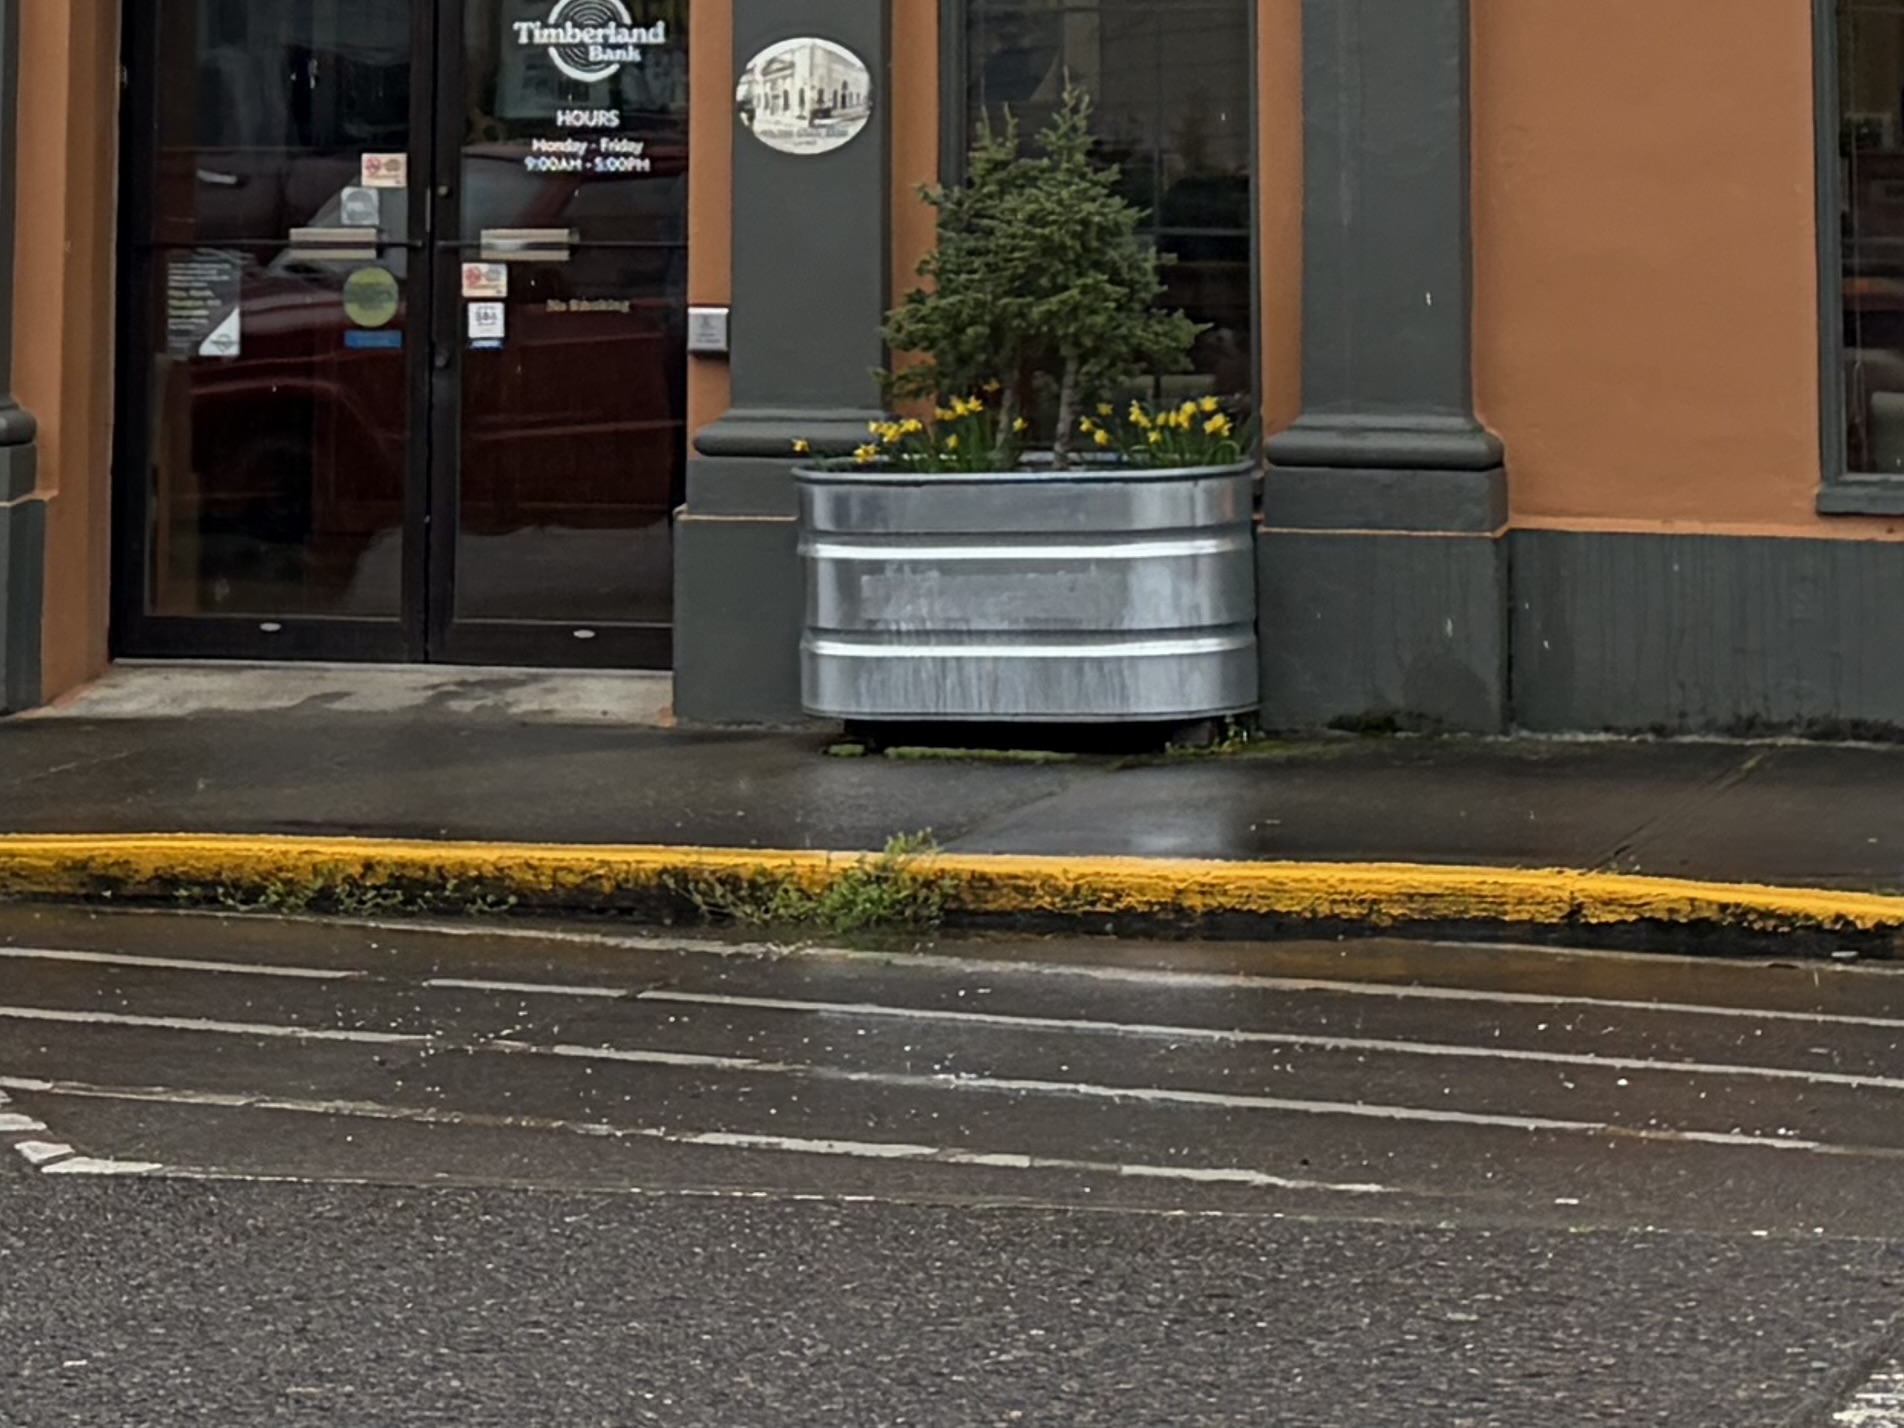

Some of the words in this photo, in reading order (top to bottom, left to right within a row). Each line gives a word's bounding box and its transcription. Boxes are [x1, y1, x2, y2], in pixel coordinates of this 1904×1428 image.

[512, 20, 667, 45] Timberland
[587, 45, 642, 62] Bank
[556, 110, 621, 128] HOURS
[532, 137, 589, 156] Monday
[599, 137, 645, 156] Friday
[524, 156, 583, 173] 9:00AM
[594, 156, 651, 173] 5:00PM
